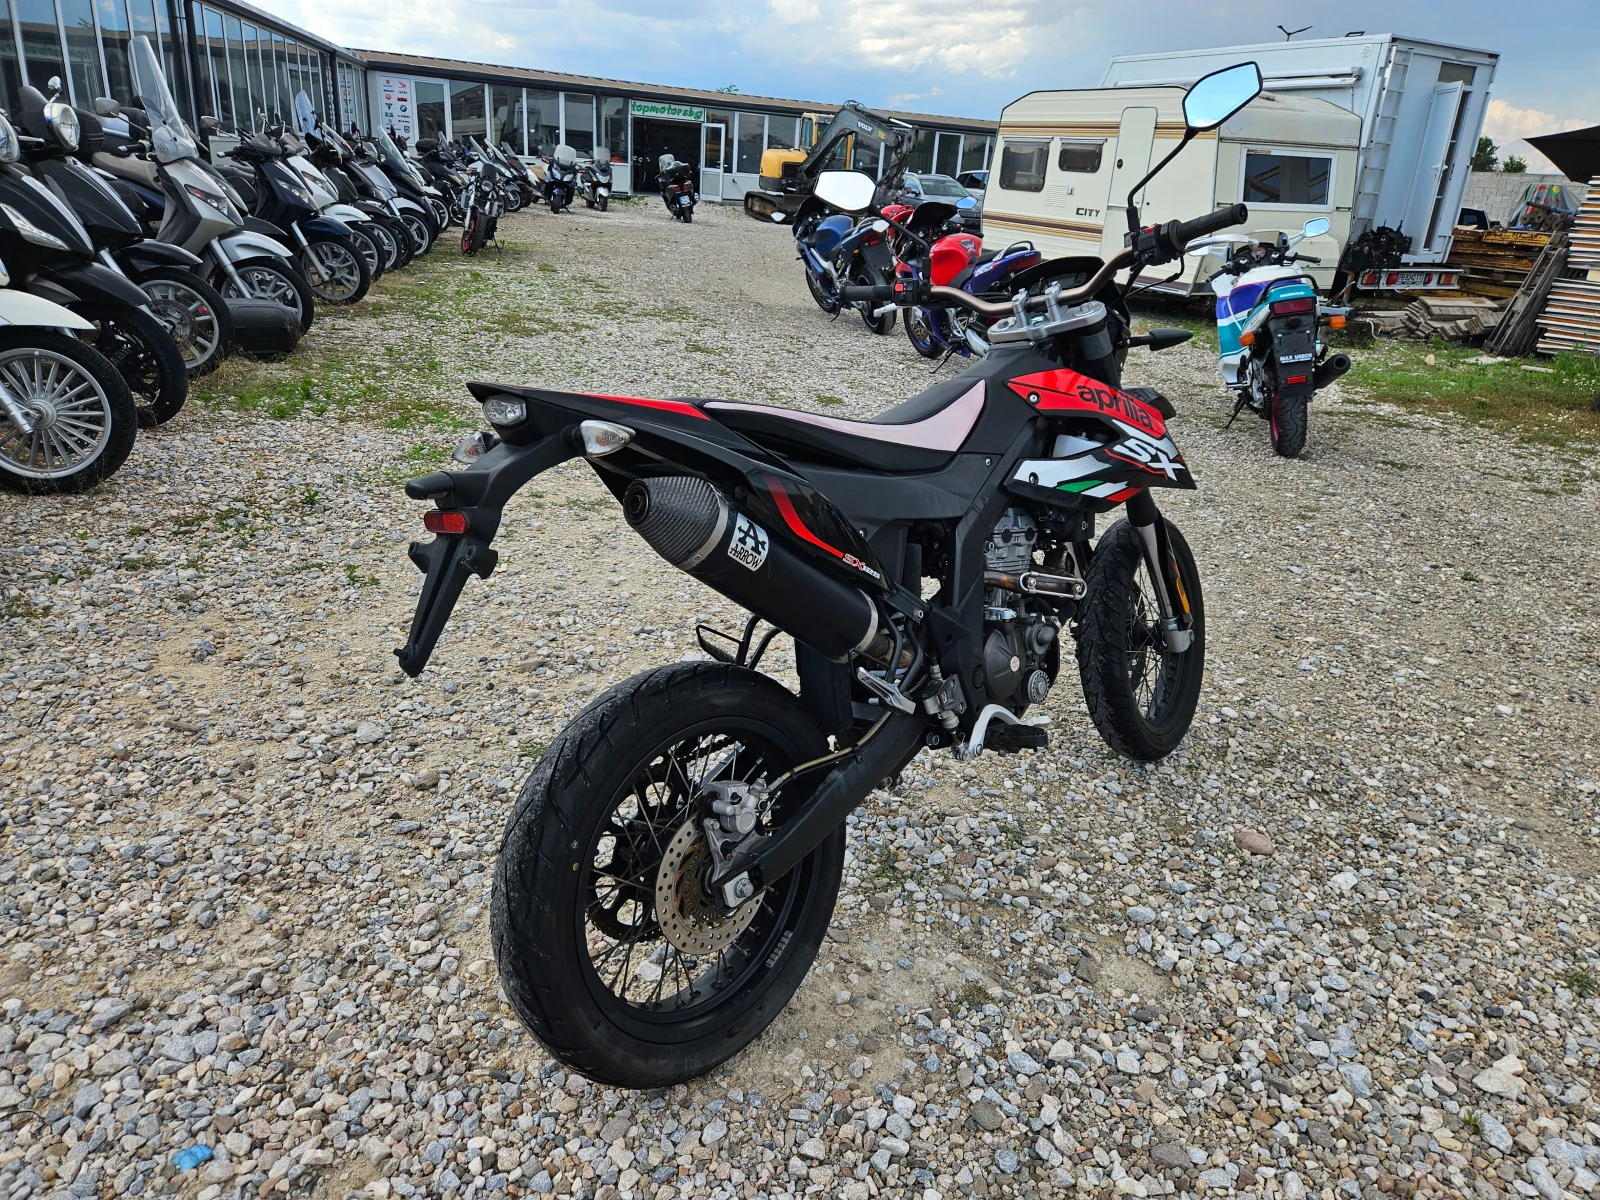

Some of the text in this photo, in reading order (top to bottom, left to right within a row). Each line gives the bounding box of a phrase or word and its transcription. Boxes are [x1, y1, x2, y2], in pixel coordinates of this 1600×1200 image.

[631, 101, 703, 119] topmotorsbg
[1076, 207, 1100, 217] CITY
[1077, 385, 1153, 430] aprilia
[1113, 438, 1186, 481] SX
[729, 543, 763, 569] ARROW
